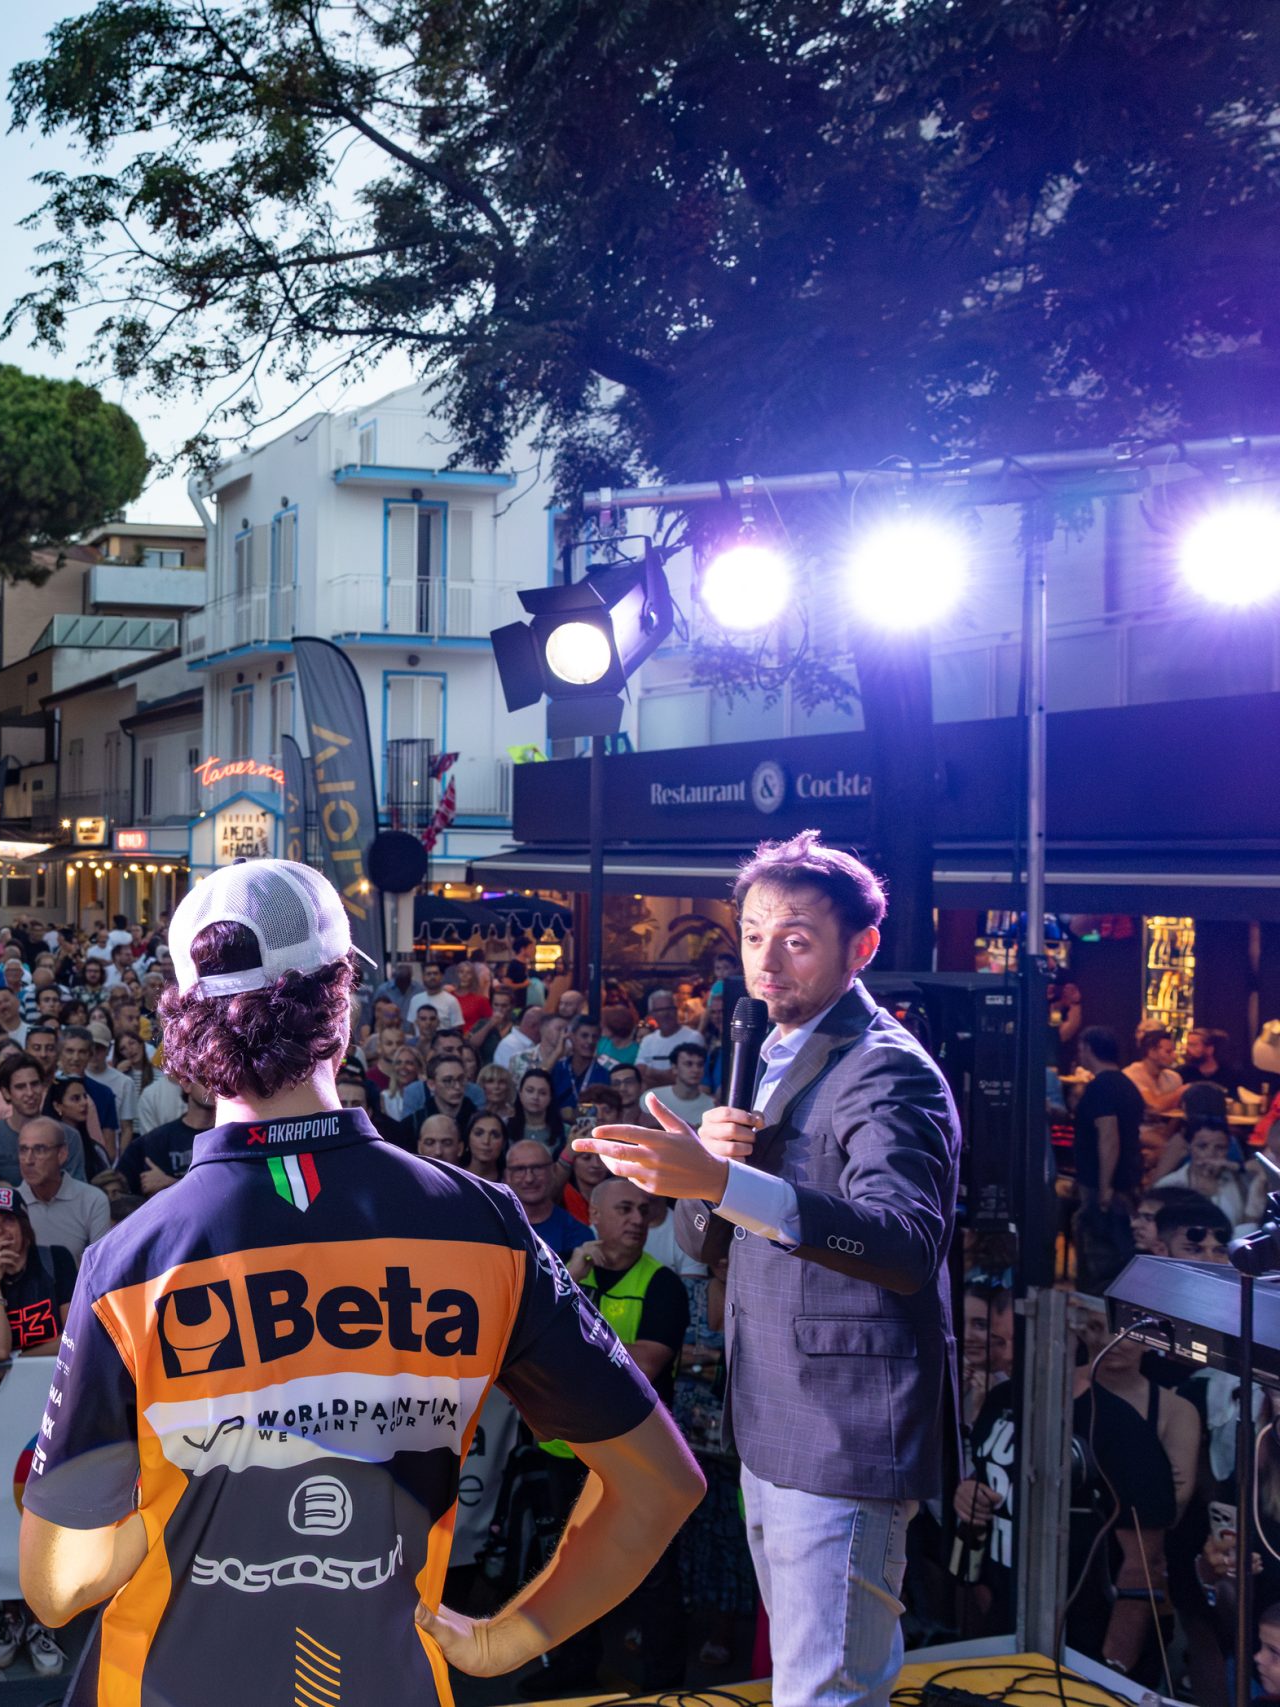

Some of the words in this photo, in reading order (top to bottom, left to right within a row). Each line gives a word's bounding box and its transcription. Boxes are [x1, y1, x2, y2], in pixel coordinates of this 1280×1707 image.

[650, 780, 746, 805] Restaurant
[244, 1266, 479, 1364] Beta
[258, 1430, 288, 1442] WE
[301, 1420, 357, 1438] PAINT
[377, 1416, 416, 1435] YOUR
